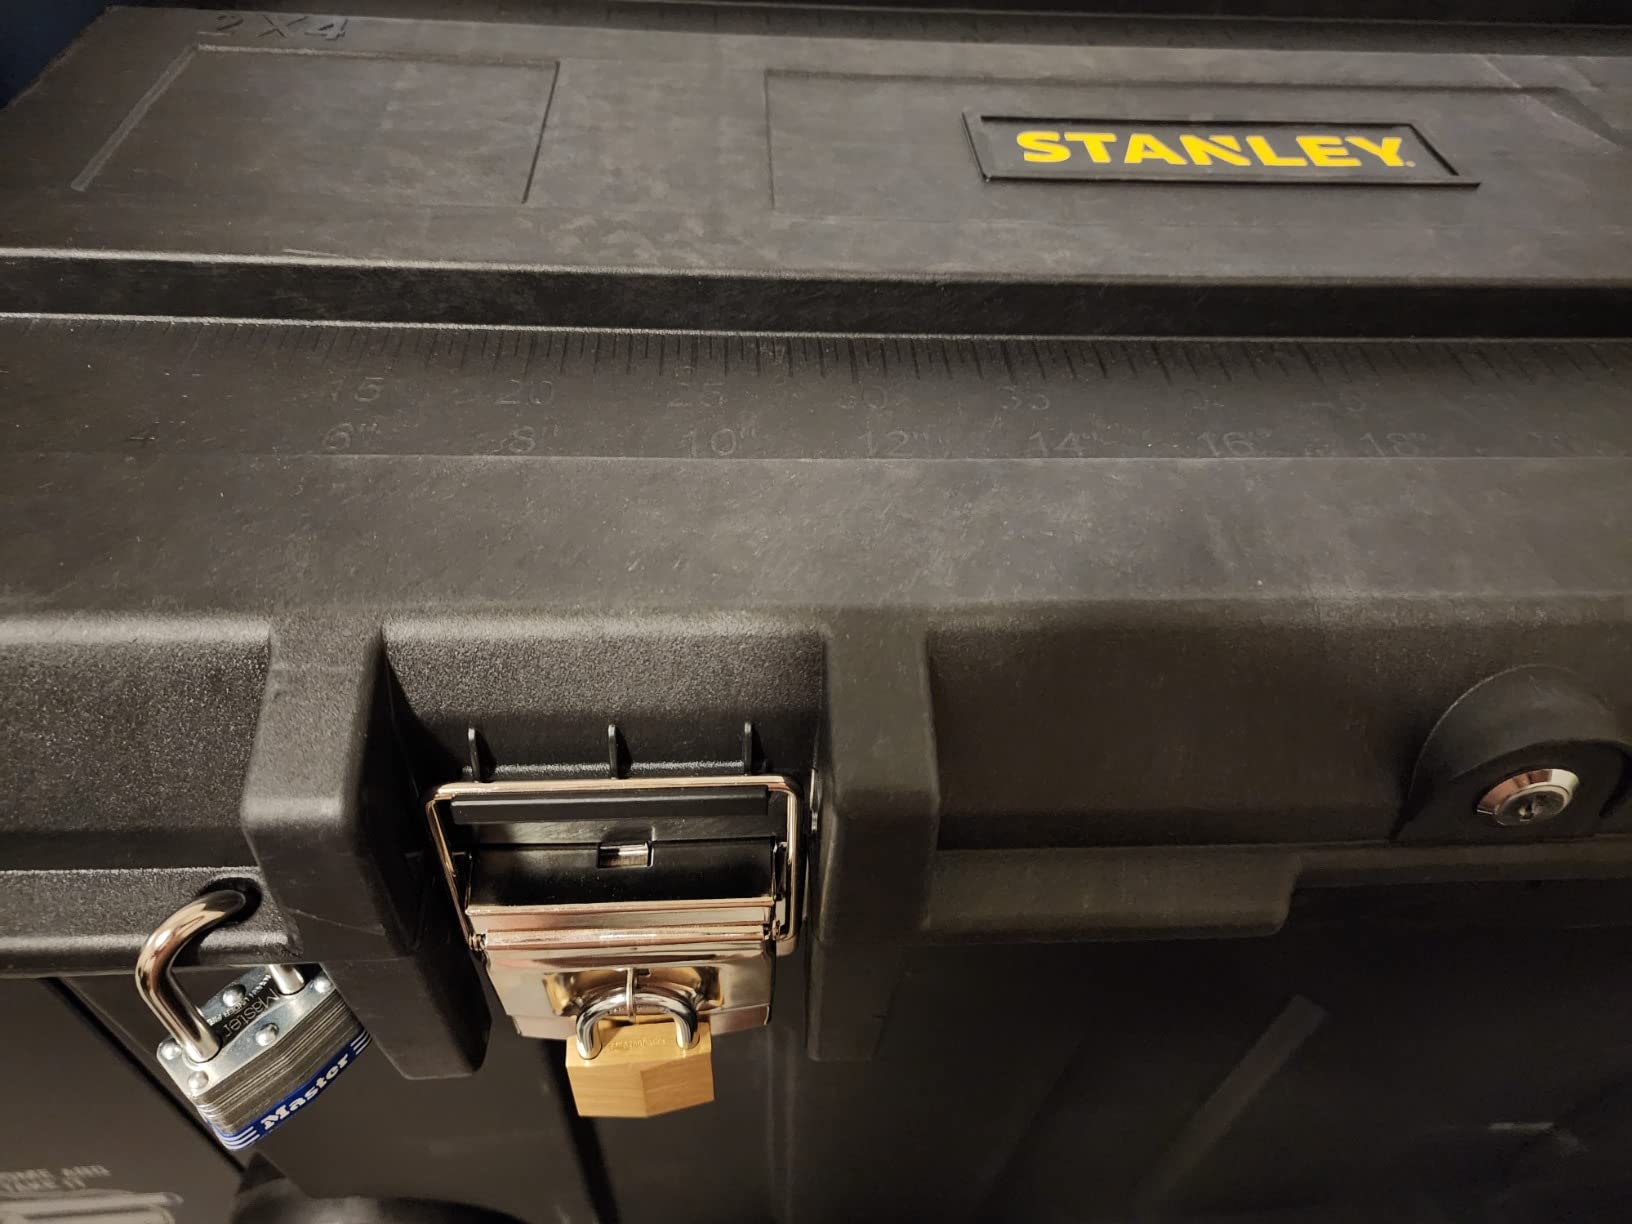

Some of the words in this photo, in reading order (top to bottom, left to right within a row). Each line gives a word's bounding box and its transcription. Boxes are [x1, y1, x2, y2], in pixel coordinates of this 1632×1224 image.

[1015, 130, 1405, 168] STANLEY
[222, 987, 282, 1038] Master
[260, 1053, 350, 1130] Master
